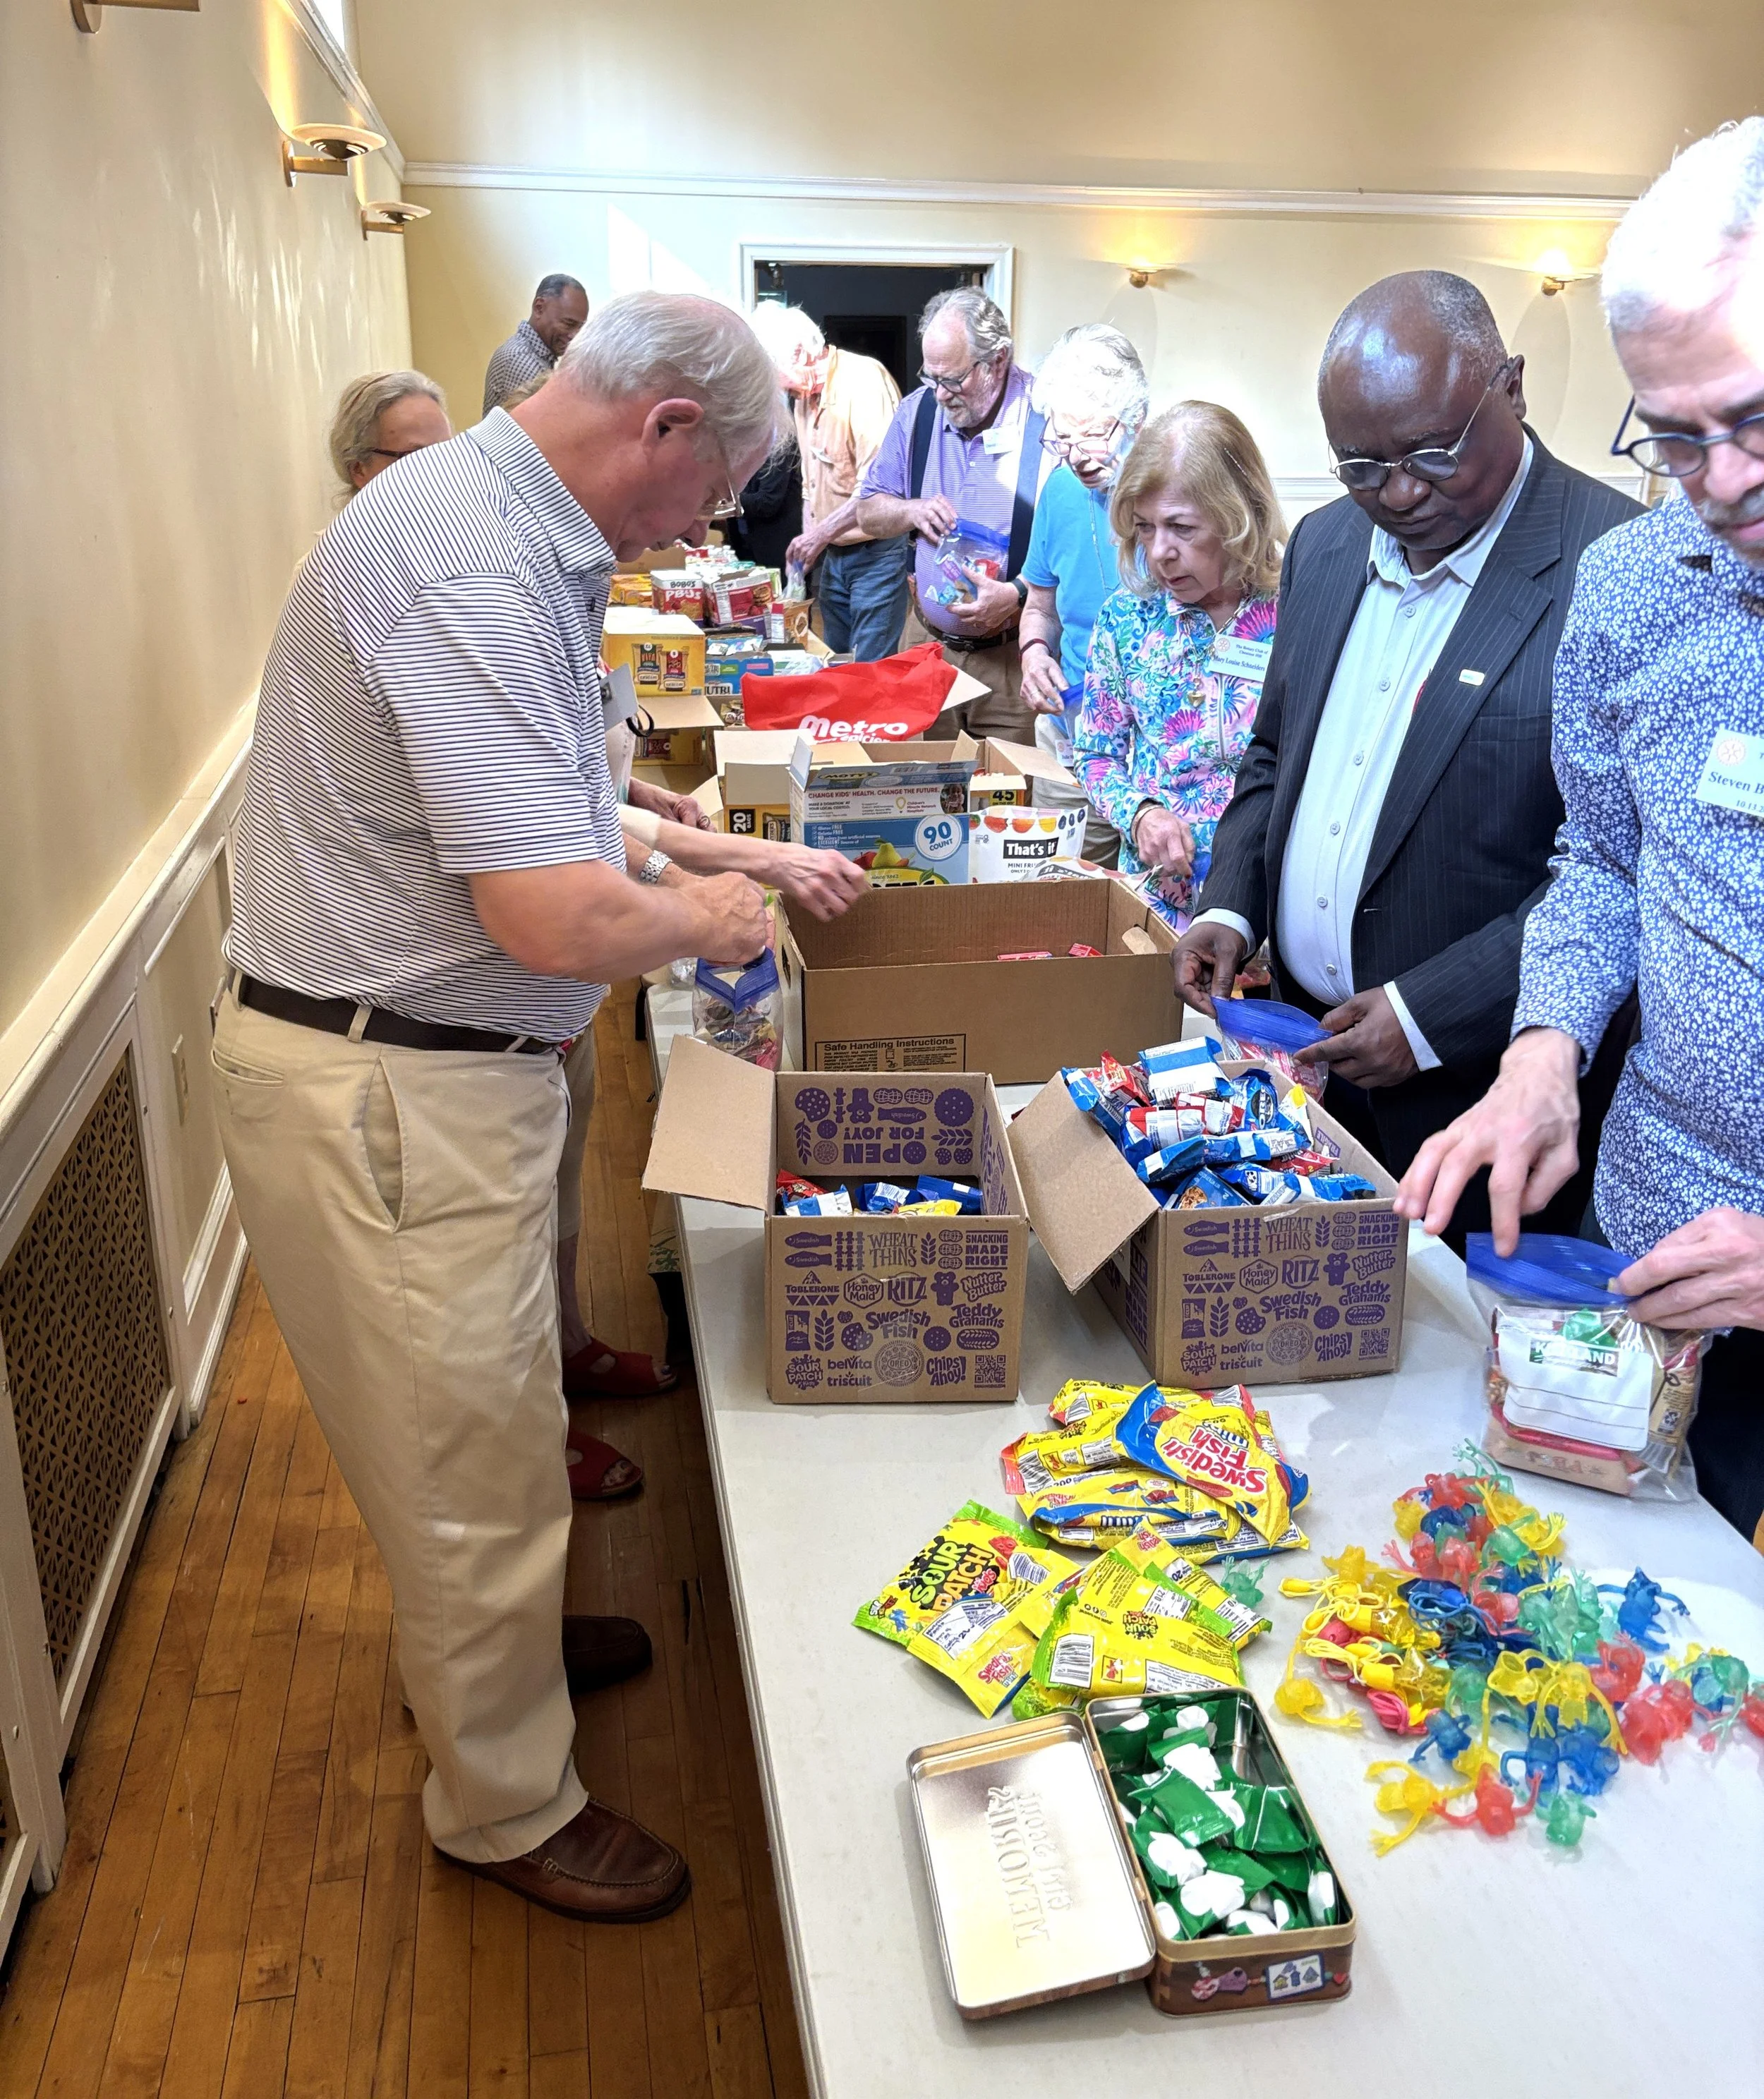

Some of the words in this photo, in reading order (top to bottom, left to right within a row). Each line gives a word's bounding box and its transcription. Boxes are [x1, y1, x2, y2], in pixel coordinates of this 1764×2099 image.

[1214, 655, 1225, 663] Mary
[1226, 658, 1240, 666] Louise
[1708, 771, 1751, 792] Steven
[993, 790, 1014, 801] 45
[733, 812, 747, 833] 20
[924, 821, 951, 844] 90
[929, 838, 953, 852] COUNT
[1006, 843, 1044, 856] That's
[824, 1043, 847, 1051] Safe
[850, 1041, 893, 1050] Handling
[896, 1038, 955, 1048] Instructions
[843, 1127, 883, 1140] JOY!
[889, 1127, 924, 1140] FOR
[1267, 1216, 1312, 1234] WHEAT
[1359, 1214, 1399, 1224] SNACKING
[1358, 1223, 1398, 1234] MADE
[867, 1232, 917, 1248] WHEAT
[966, 1235, 1008, 1243] SNACKING
[1358, 1234, 1398, 1245] RIGHT
[965, 1245, 1008, 1254] MADE
[965, 1256, 1008, 1265] RIGHT
[1353, 1250, 1391, 1268] Nutter
[1183, 1272, 1236, 1282] TOBLERONE
[1243, 1269, 1275, 1279] Honey
[1282, 1259, 1319, 1284] RITZ
[1358, 1259, 1395, 1280] Butter
[847, 1282, 881, 1294] Honey
[888, 1276, 927, 1301] RITZ
[962, 1272, 1001, 1290] Nutter
[1245, 1277, 1269, 1287] Maid
[785, 1285, 840, 1293] TOBLERONE
[850, 1291, 876, 1301] Maid
[968, 1281, 1007, 1302] Butter
[1341, 1281, 1390, 1297] Teddy
[1259, 1291, 1322, 1313] Swedish
[1339, 1293, 1391, 1305] Grahams
[951, 1303, 1003, 1319] Teddy
[1274, 1305, 1308, 1321] Fish
[866, 1309, 931, 1330] Swedish
[949, 1317, 1004, 1328] Grahams
[882, 1323, 917, 1338] Fish
[1315, 1333, 1346, 1353] Chips
[1317, 1332, 1352, 1362] Ahoy!
[1183, 1348, 1213, 1360] SOUR
[788, 1362, 820, 1373] SOUR
[926, 1357, 960, 1375] Chips
[1183, 1357, 1215, 1369] PATCH
[1220, 1355, 1263, 1370] triscuit
[788, 1372, 822, 1384] PATCH
[930, 1356, 967, 1386] Ahoy!
[827, 1372, 872, 1387] triscuit
[1191, 1429, 1248, 1472] Fish
[1162, 1439, 1267, 1494] Swedish
[910, 1540, 967, 1604] SOUR
[931, 1546, 992, 1611] PATCH
[1123, 1614, 1156, 1624] PATCH
[1124, 1623, 1156, 1634] SOUR
[978, 1652, 1013, 1684] Swedish
[991, 1664, 1014, 1682] Fish
